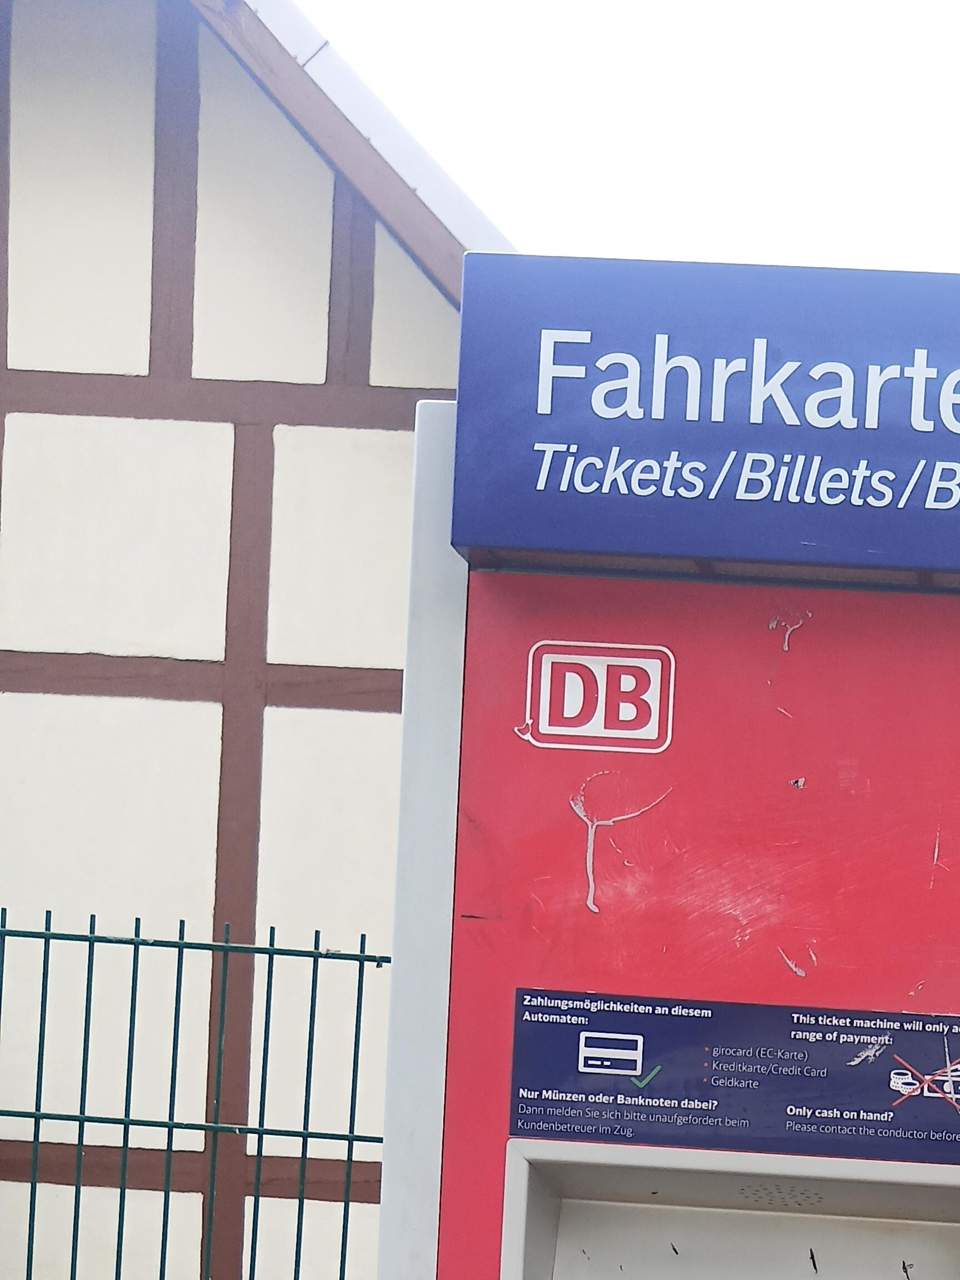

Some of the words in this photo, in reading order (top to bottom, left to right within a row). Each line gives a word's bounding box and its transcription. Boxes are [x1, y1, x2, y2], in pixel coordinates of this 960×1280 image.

[548, 661, 652, 731] DB
[523, 995, 652, 1015] Zahlungsmöglichkeiten
[655, 1007, 669, 1015] an
[671, 1006, 712, 1018] diesem
[523, 1011, 589, 1026] Automaten:
[792, 1014, 816, 1026] This
[818, 1015, 850, 1027] ticket
[853, 1017, 900, 1030] machine
[903, 1020, 923, 1031] will
[925, 1022, 950, 1035] only
[791, 1030, 822, 1042] range
[825, 1030, 838, 1041] of
[840, 1033, 893, 1047] payment:
[712, 1046, 753, 1059] girocard
[755, 1047, 807, 1061] (EC-Karte)
[712, 1061, 801, 1077] Kreditkarte/Credit
[804, 1066, 827, 1078] Card
[711, 1077, 759, 1089] Geldkarte
[519, 1088, 539, 1099] Nur
[541, 1088, 586, 1103] Münzen
[588, 1092, 614, 1105] oder
[616, 1094, 678, 1108] Banknoten
[680, 1098, 718, 1111] dabei?
[518, 1103, 545, 1115] Dann
[547, 1106, 583, 1117] melden
[585, 1108, 600, 1118] Sie
[602, 1109, 621, 1119] sich
[623, 1110, 647, 1121] bitte
[649, 1112, 723, 1128] unaufgefordert
[725, 1117, 749, 1127] beim
[787, 1106, 813, 1119] Only
[815, 1108, 841, 1119] cash
[843, 1111, 857, 1119] on
[860, 1110, 893, 1121] hand?
[517, 1120, 596, 1134] Kundenbetreuer
[599, 1125, 611, 1134] im
[613, 1126, 635, 1137] Zug.
[786, 1121, 817, 1133] Please
[819, 1124, 857, 1136] contact
[859, 1125, 875, 1136] the
[877, 1127, 928, 1139] conductor
